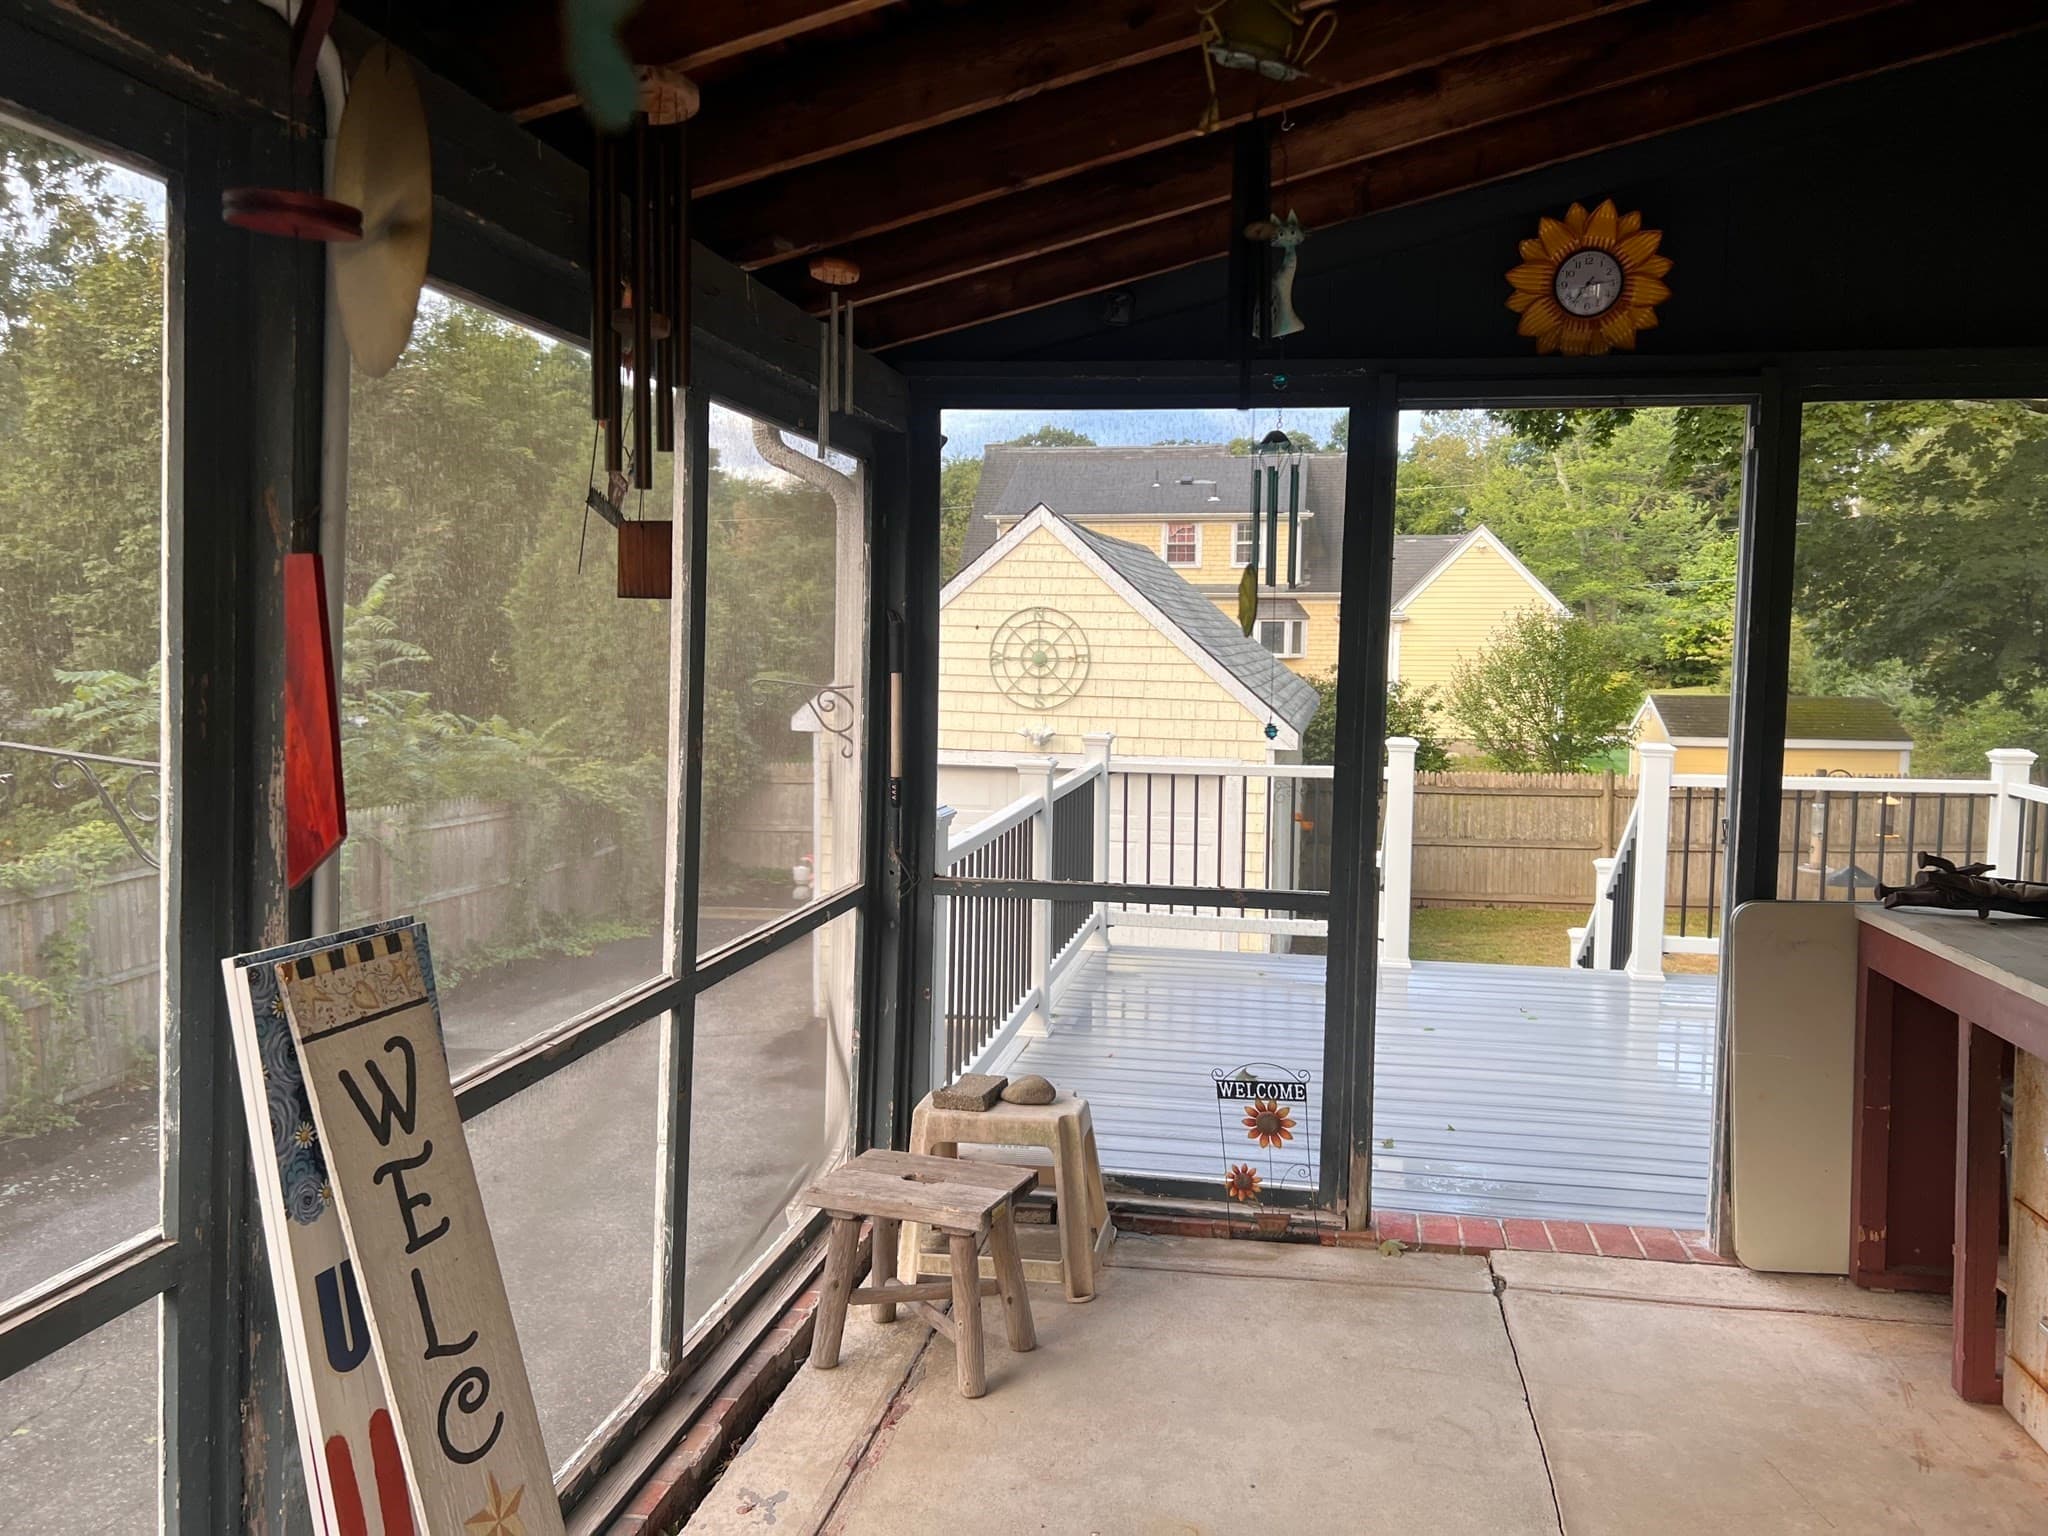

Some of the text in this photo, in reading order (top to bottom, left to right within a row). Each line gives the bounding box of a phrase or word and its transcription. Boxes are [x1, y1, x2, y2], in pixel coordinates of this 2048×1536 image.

[1575, 261, 1582, 269] 11
[1584, 257, 1594, 265] 12
[1565, 270, 1575, 278] 10
[1034, 608, 1045, 621] N
[1034, 695, 1046, 709] S
[1218, 1081, 1306, 1100] WELCOME
